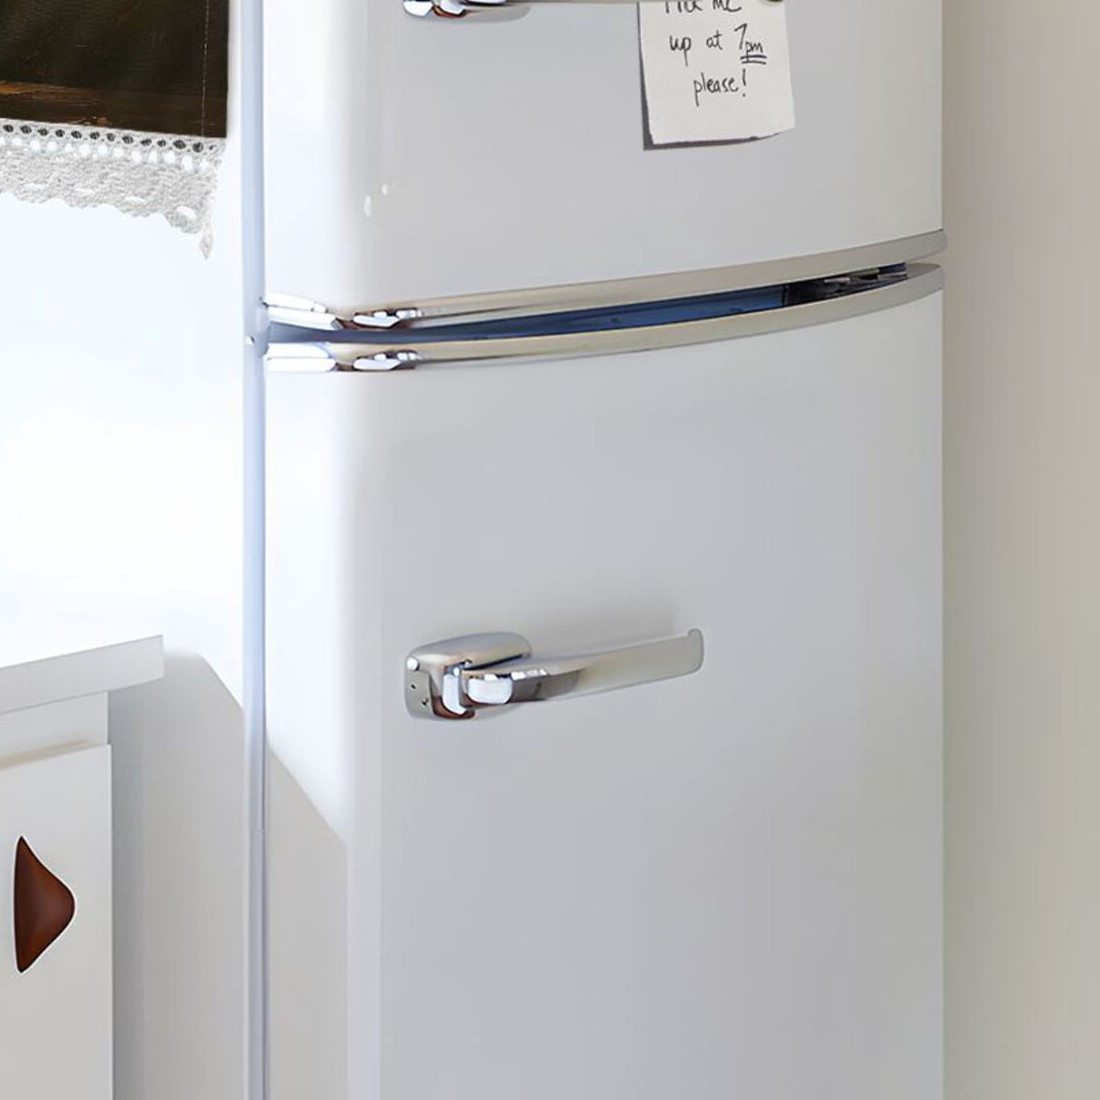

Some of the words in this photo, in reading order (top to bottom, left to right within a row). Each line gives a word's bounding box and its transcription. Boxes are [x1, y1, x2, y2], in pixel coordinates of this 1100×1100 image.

[669, 35, 691, 66] up
[706, 30, 723, 50] at
[693, 69, 746, 107] please!
